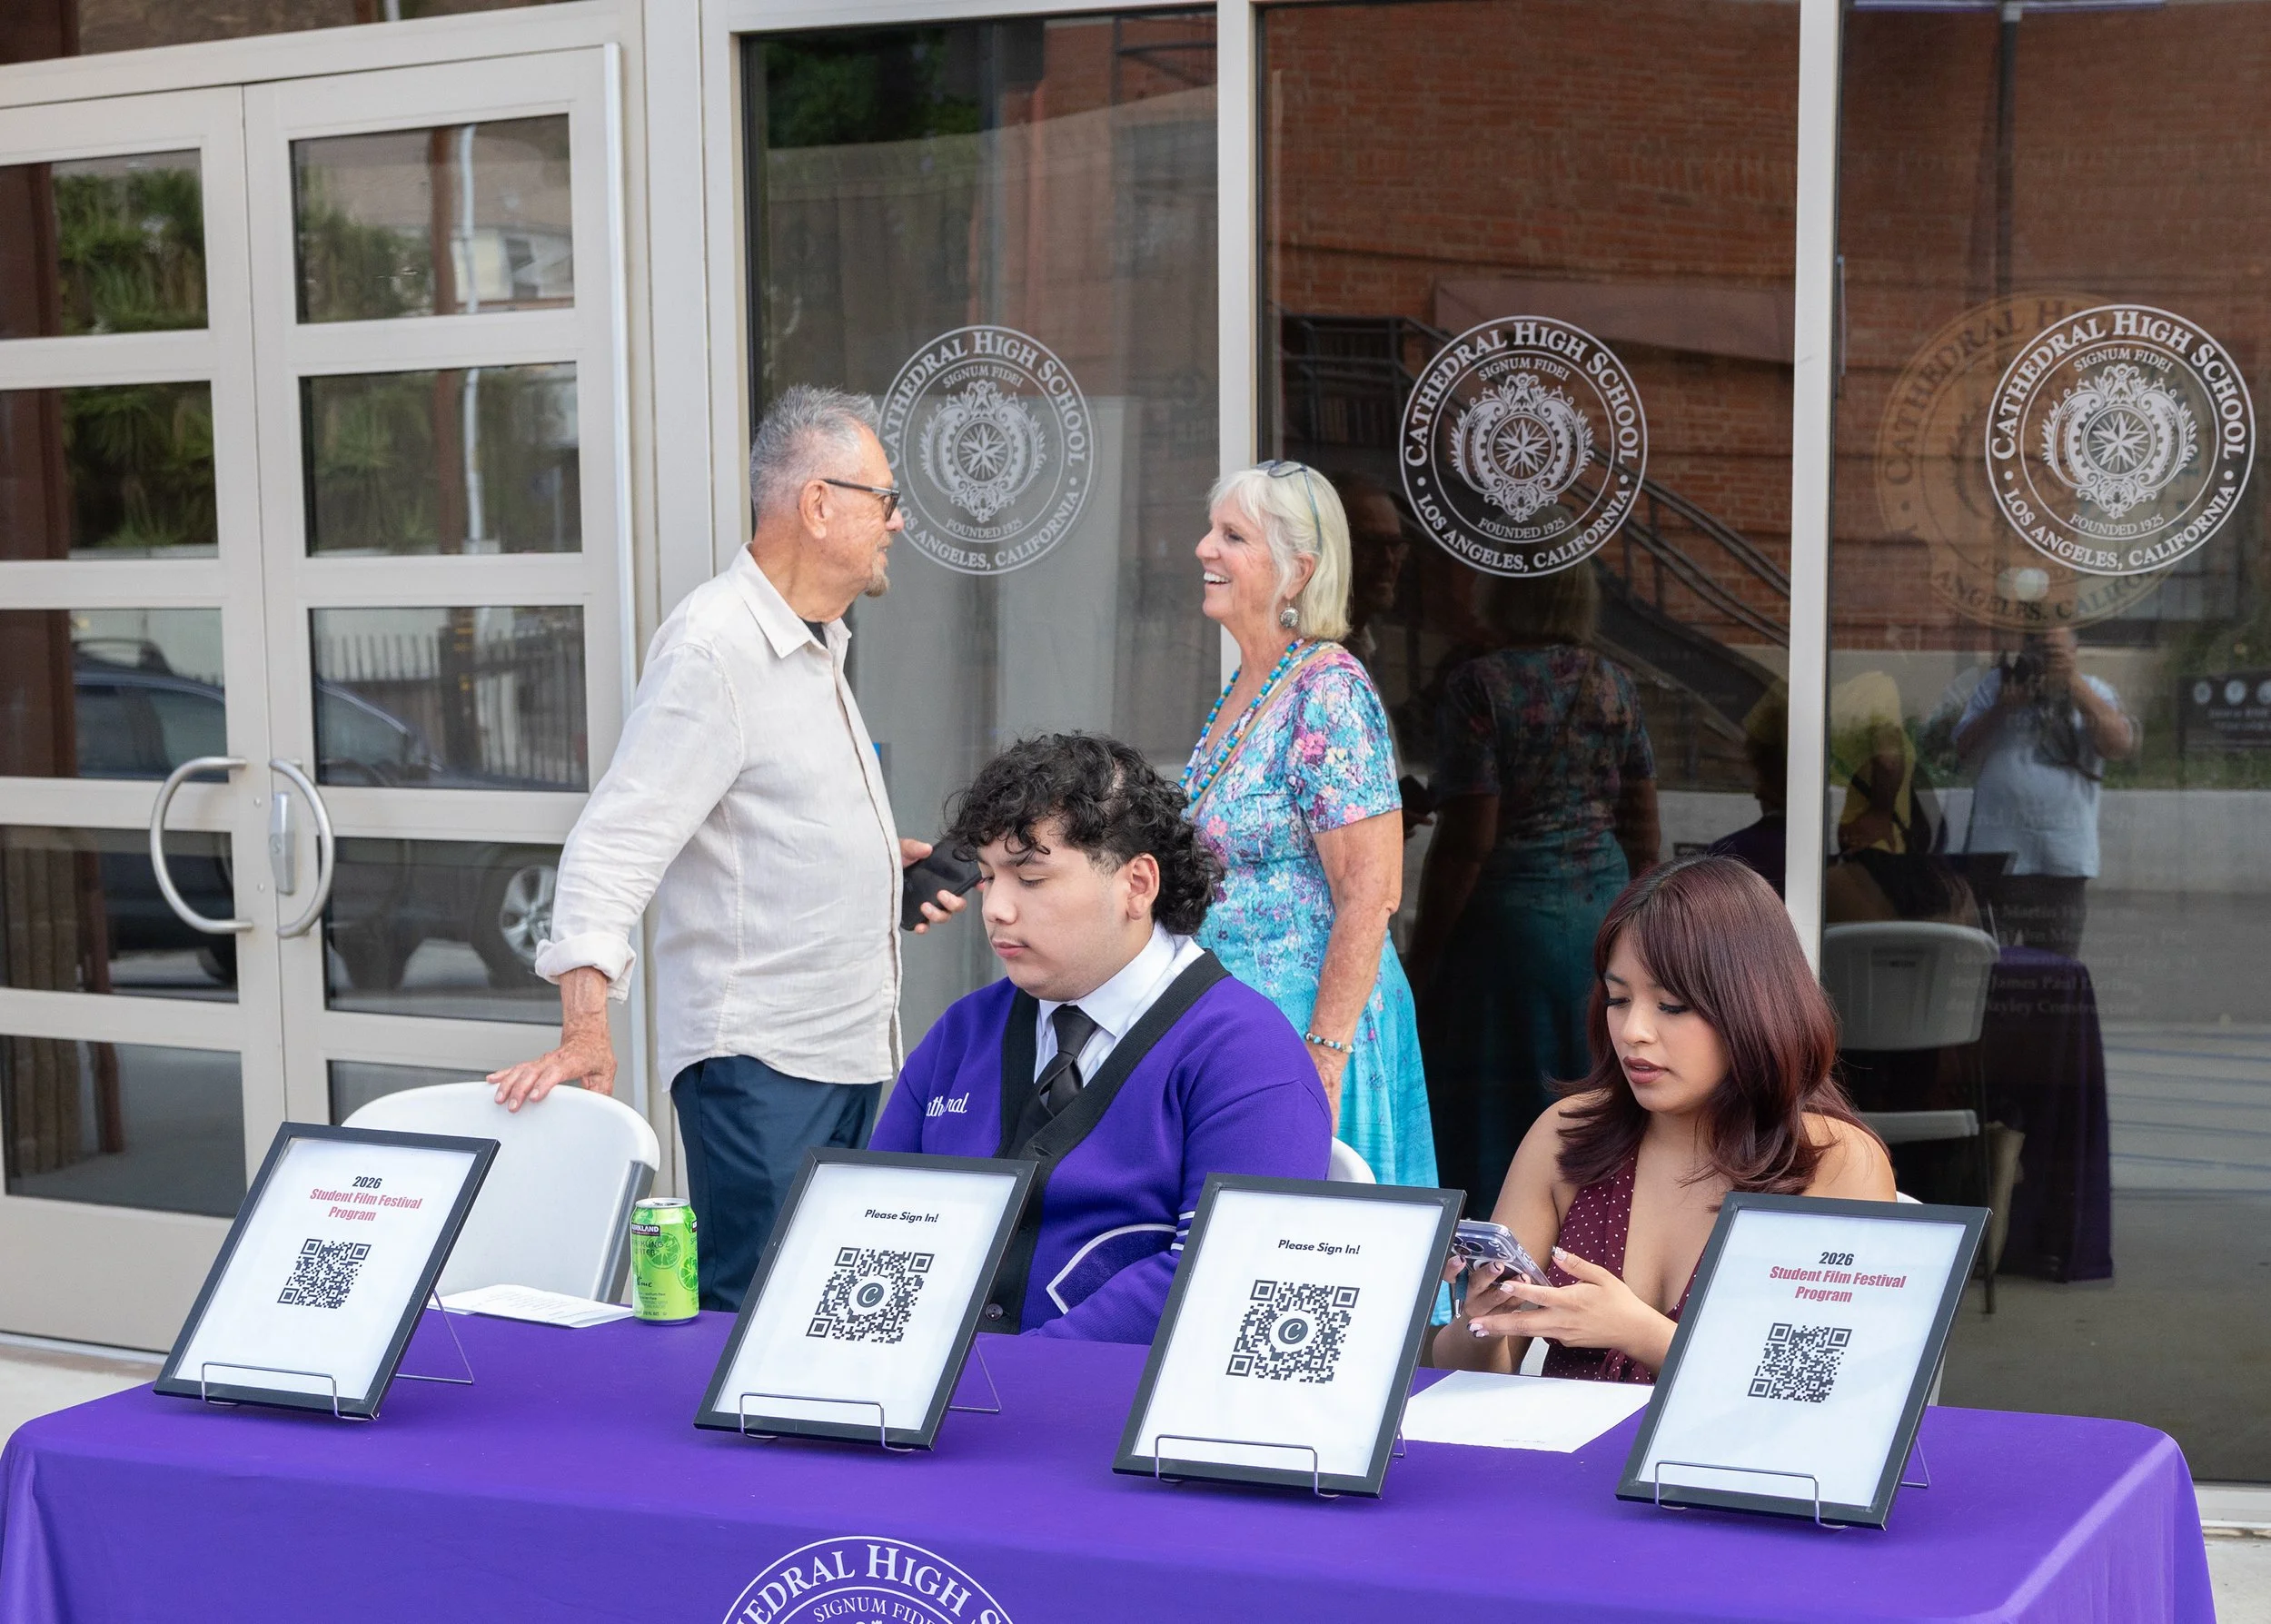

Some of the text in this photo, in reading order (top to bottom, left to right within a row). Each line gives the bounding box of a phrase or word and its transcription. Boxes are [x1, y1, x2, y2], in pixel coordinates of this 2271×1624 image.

[1478, 357, 1572, 382] SIGNUM FIDEI
[2073, 348, 2174, 373] SIGNUM FIDEI
[942, 365, 1025, 389] SIGNUM FIDEI
[1991, 311, 2246, 460] CATHEDRAL HIGH SCHOOL
[972, 331, 1040, 371] HIGH
[1036, 360, 1086, 467] SCHOOL
[1404, 322, 1640, 467] CATHEDRAL HIGH SCHOOL
[915, 529, 992, 571] ANGELES,
[994, 490, 1080, 567] CALIFORNIA
[945, 518, 1000, 538] FOUNDED
[1417, 489, 1631, 573] LOS ANGELES, CALIFORNIA
[1477, 517, 1566, 540] FOUNDED 1925
[2003, 486, 2236, 571] LOS ANGELES, CALIFORNIA
[2068, 513, 2166, 537] FOUNDED 1925
[352, 1175, 383, 1189] 2026
[310, 1188, 422, 1209] Student Film Festival
[328, 1206, 377, 1222] Program
[865, 1209, 939, 1223] Please Sign In!
[1277, 1239, 1361, 1255] Please Sign In!
[1819, 1252, 1855, 1266] 2026
[1770, 1266, 1907, 1288] Student Film Festival
[1795, 1286, 1853, 1302] Program
[737, 1543, 973, 1624] EDRAL HIGH
[813, 1597, 888, 1623] SIGNUM
